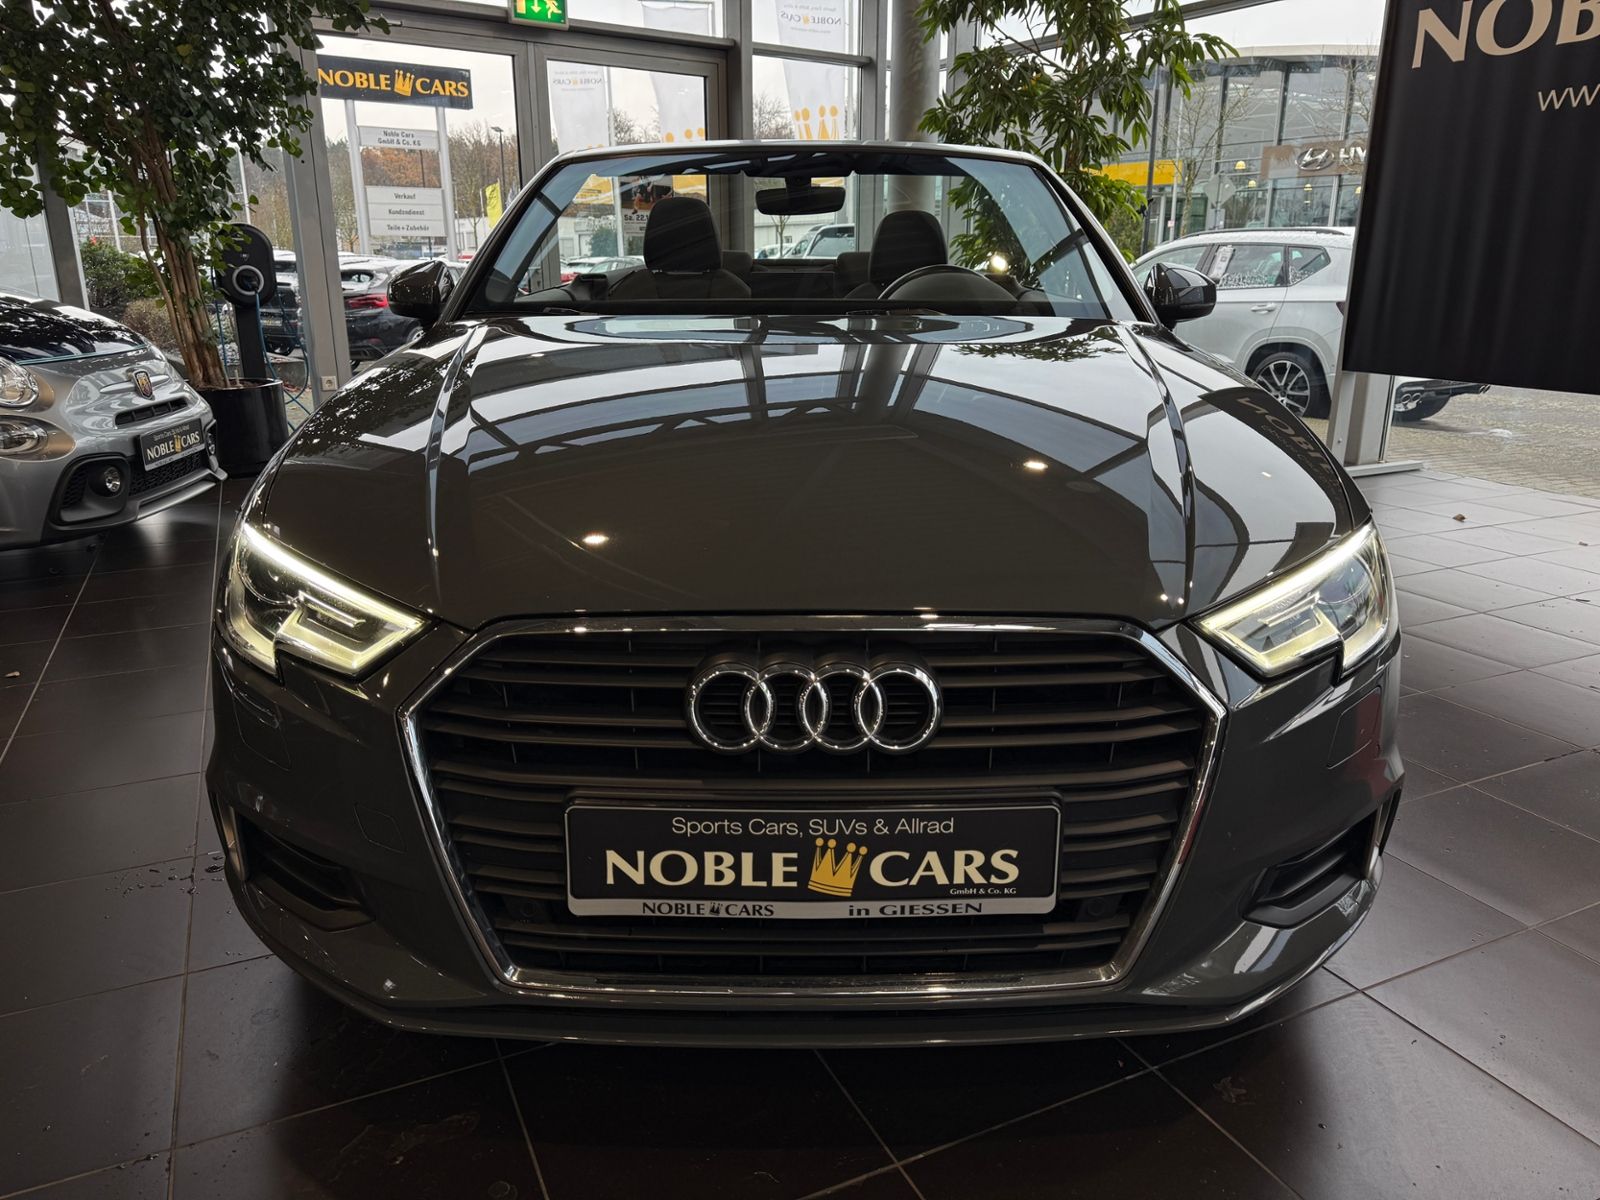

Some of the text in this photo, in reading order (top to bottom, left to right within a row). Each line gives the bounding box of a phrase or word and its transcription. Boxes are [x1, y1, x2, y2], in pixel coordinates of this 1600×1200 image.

[318, 68, 469, 97] NOBLE CARS
[393, 192, 416, 200] Verkauf
[146, 440, 175, 460] NOBLE
[181, 431, 200, 448] CARS
[671, 816, 955, 838] Sports Cars, SUVs & Allrad
[605, 848, 1020, 888] NOBLE CARS
[950, 887, 1017, 895] GmbH & Co. KG
[642, 902, 983, 917] NOBLE CARS in GIESSEN
